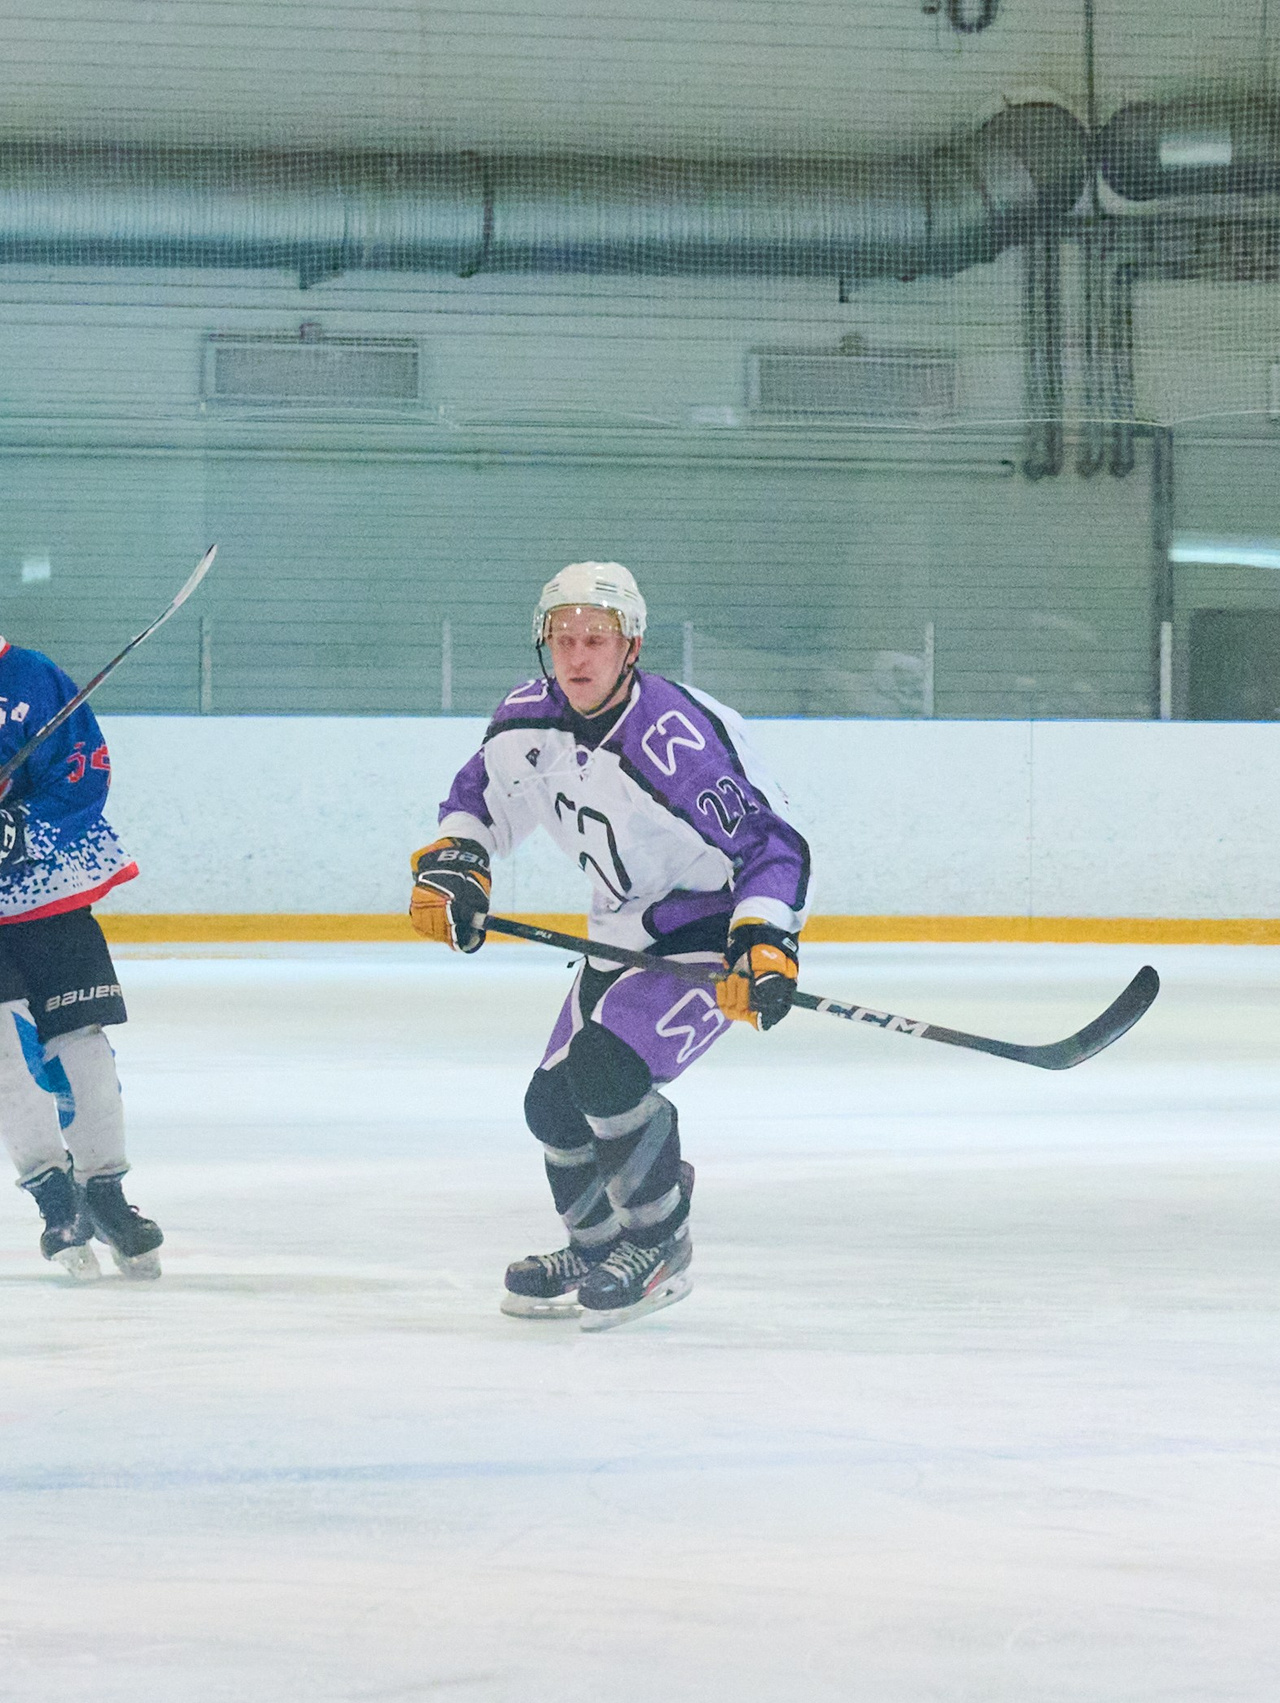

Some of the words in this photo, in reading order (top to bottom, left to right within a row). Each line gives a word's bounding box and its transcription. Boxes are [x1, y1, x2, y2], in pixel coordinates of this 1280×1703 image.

[697, 775, 760, 838] 22
[45, 984, 122, 1012] BAUER
[816, 998, 930, 1038] CCM
